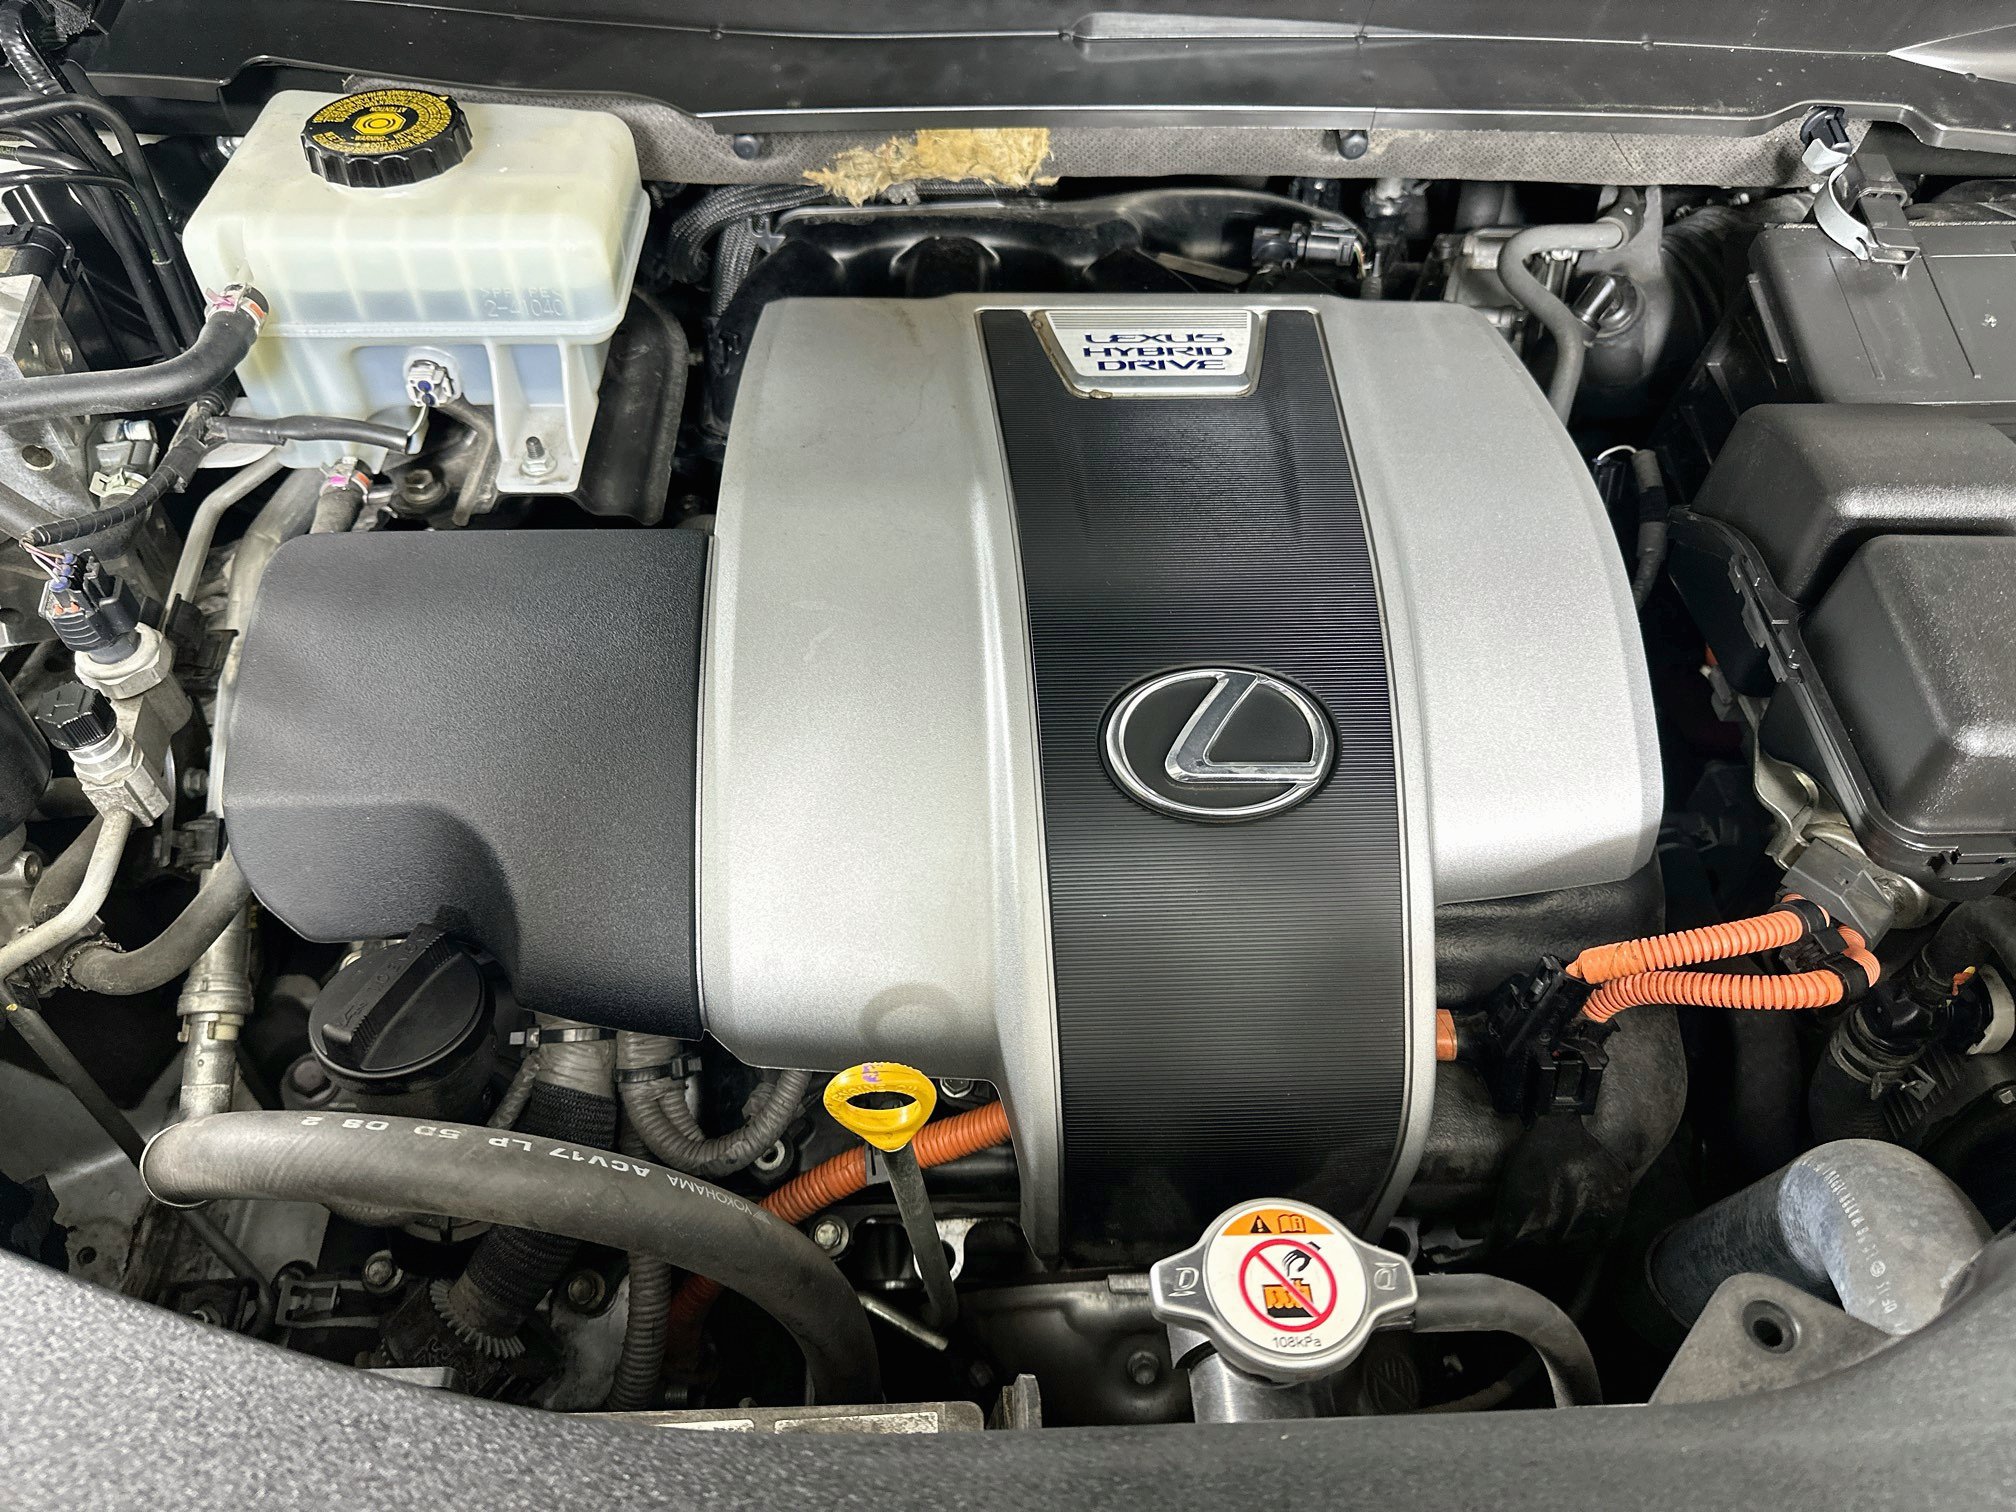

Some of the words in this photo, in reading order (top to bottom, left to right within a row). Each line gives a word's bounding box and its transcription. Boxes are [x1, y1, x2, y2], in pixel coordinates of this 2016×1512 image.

[1084, 333, 1225, 344] LEXUS
[1082, 346, 1233, 357] HYBRID
[1097, 359, 1226, 371] DRIVE
[301, 1116, 324, 1126] 2
[488, 1137, 533, 1152] LP
[549, 1147, 651, 1178] ACV17
[667, 1173, 753, 1216] YOKOHAMA
[1272, 1334, 1322, 1349] 108kPa
